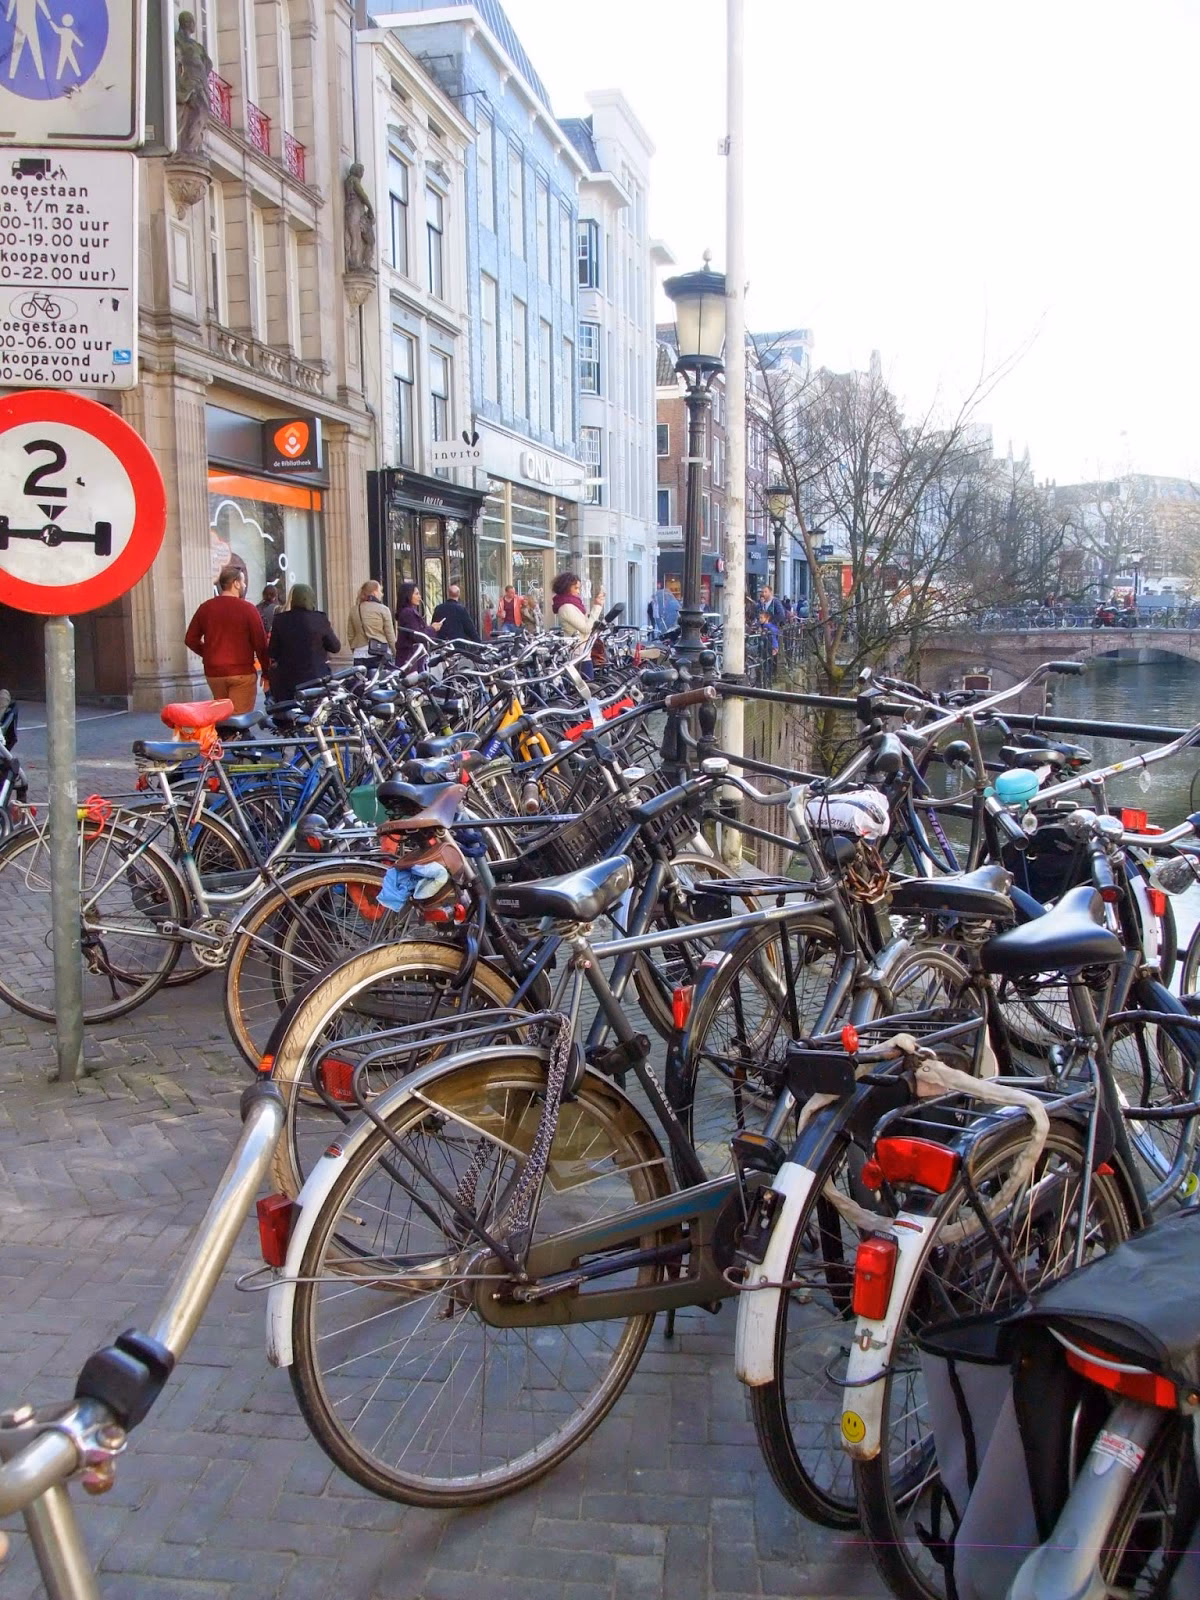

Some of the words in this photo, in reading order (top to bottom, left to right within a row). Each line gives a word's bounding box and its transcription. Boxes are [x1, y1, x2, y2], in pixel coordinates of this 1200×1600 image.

[0, 183, 88, 200] oegestaan
[26, 199, 59, 214] t/m
[66, 204, 90, 214] za.
[0, 216, 73, 231] 00-11.30
[80, 221, 110, 232] uur
[0, 233, 73, 248] 00-19.00
[80, 238, 110, 248] uur
[1, 251, 90, 266] koopavond
[0, 266, 73, 281] 0-22.00
[80, 268, 116, 282] uur)
[0, 320, 88, 335] oegestaan
[83, 341, 113, 351] uur
[3, 352, 90, 369] koopavond
[80, 371, 116, 384] uur)
[23, 439, 68, 498] 2
[522, 451, 555, 486] ONLY
[644, 1062, 678, 1121] GAZELLE
